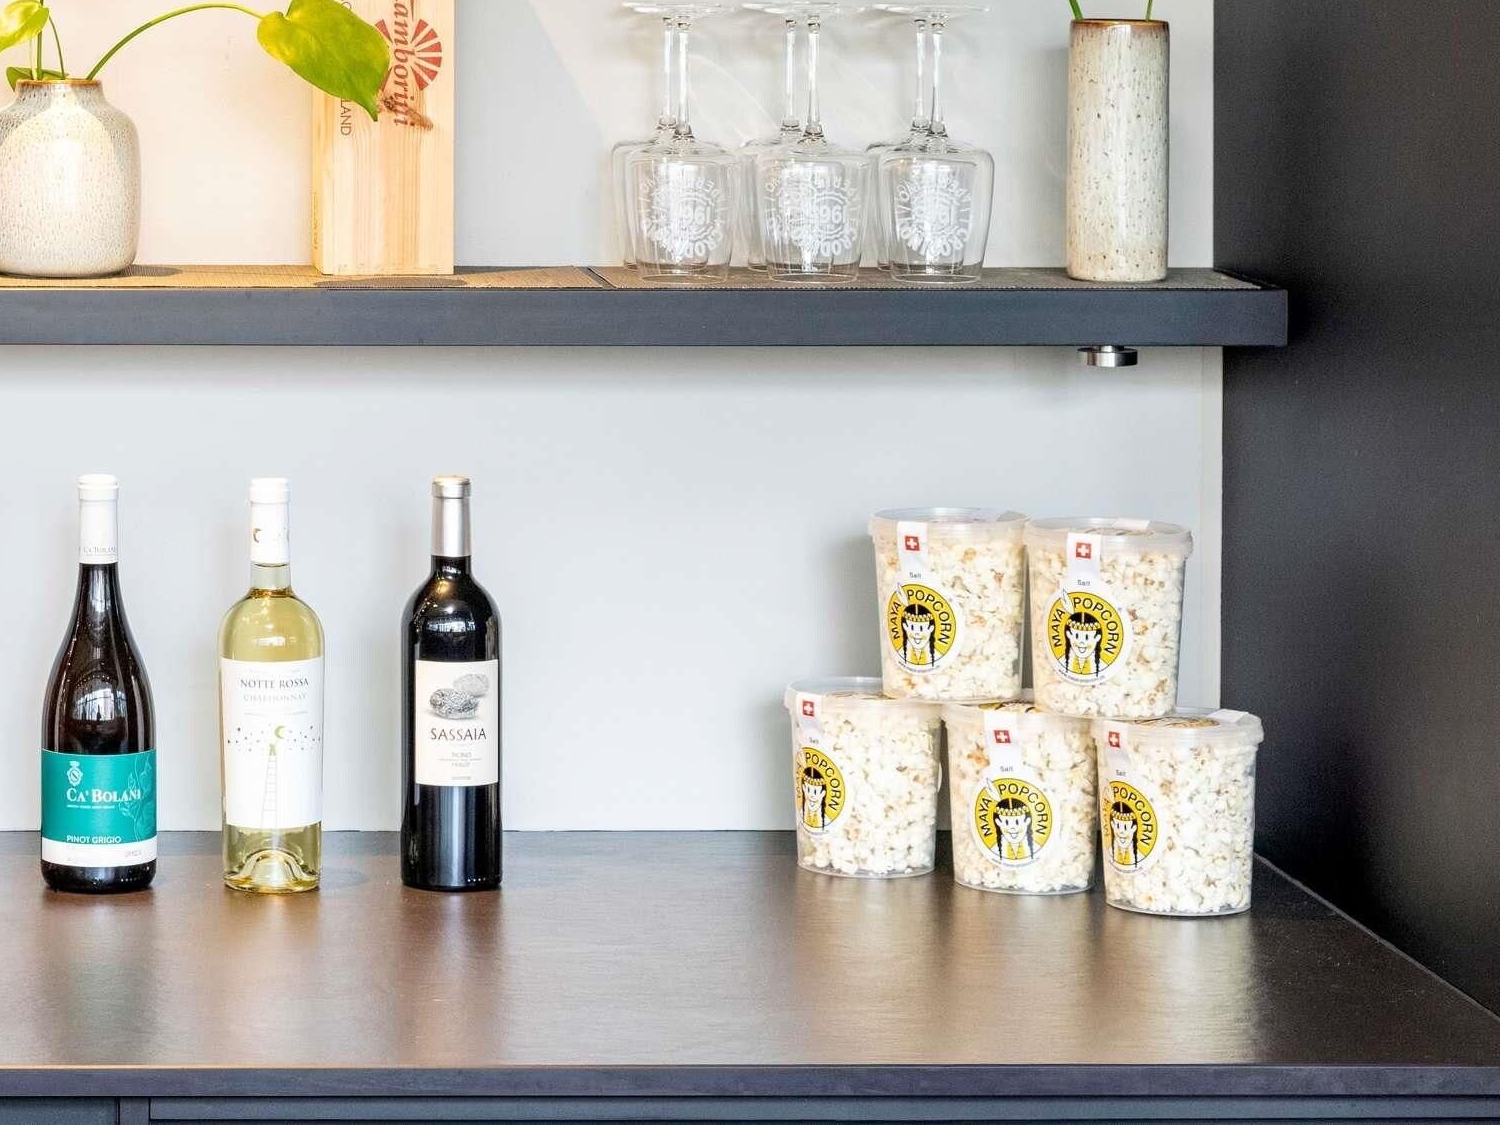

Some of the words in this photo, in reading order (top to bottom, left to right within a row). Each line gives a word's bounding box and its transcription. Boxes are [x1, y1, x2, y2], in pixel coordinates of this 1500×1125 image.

[890, 601, 901, 640] MAYA
[906, 589, 952, 645] POPCORN
[1052, 608, 1065, 647] MAYA
[1073, 596, 1119, 654] POPCORN
[240, 678, 276, 689] NOTTE
[279, 678, 309, 689] ROSSA
[430, 727, 487, 741] SASSAIA
[66, 787, 89, 803] CA'
[92, 788, 141, 803] BOLANI
[805, 752, 842, 811] POPCORN
[979, 797, 993, 837] MAYA
[998, 782, 1049, 835] POPCORN
[1113, 786, 1154, 846] POPCORN
[66, 835, 91, 844] PINOT
[92, 835, 122, 844] GRIGIO
